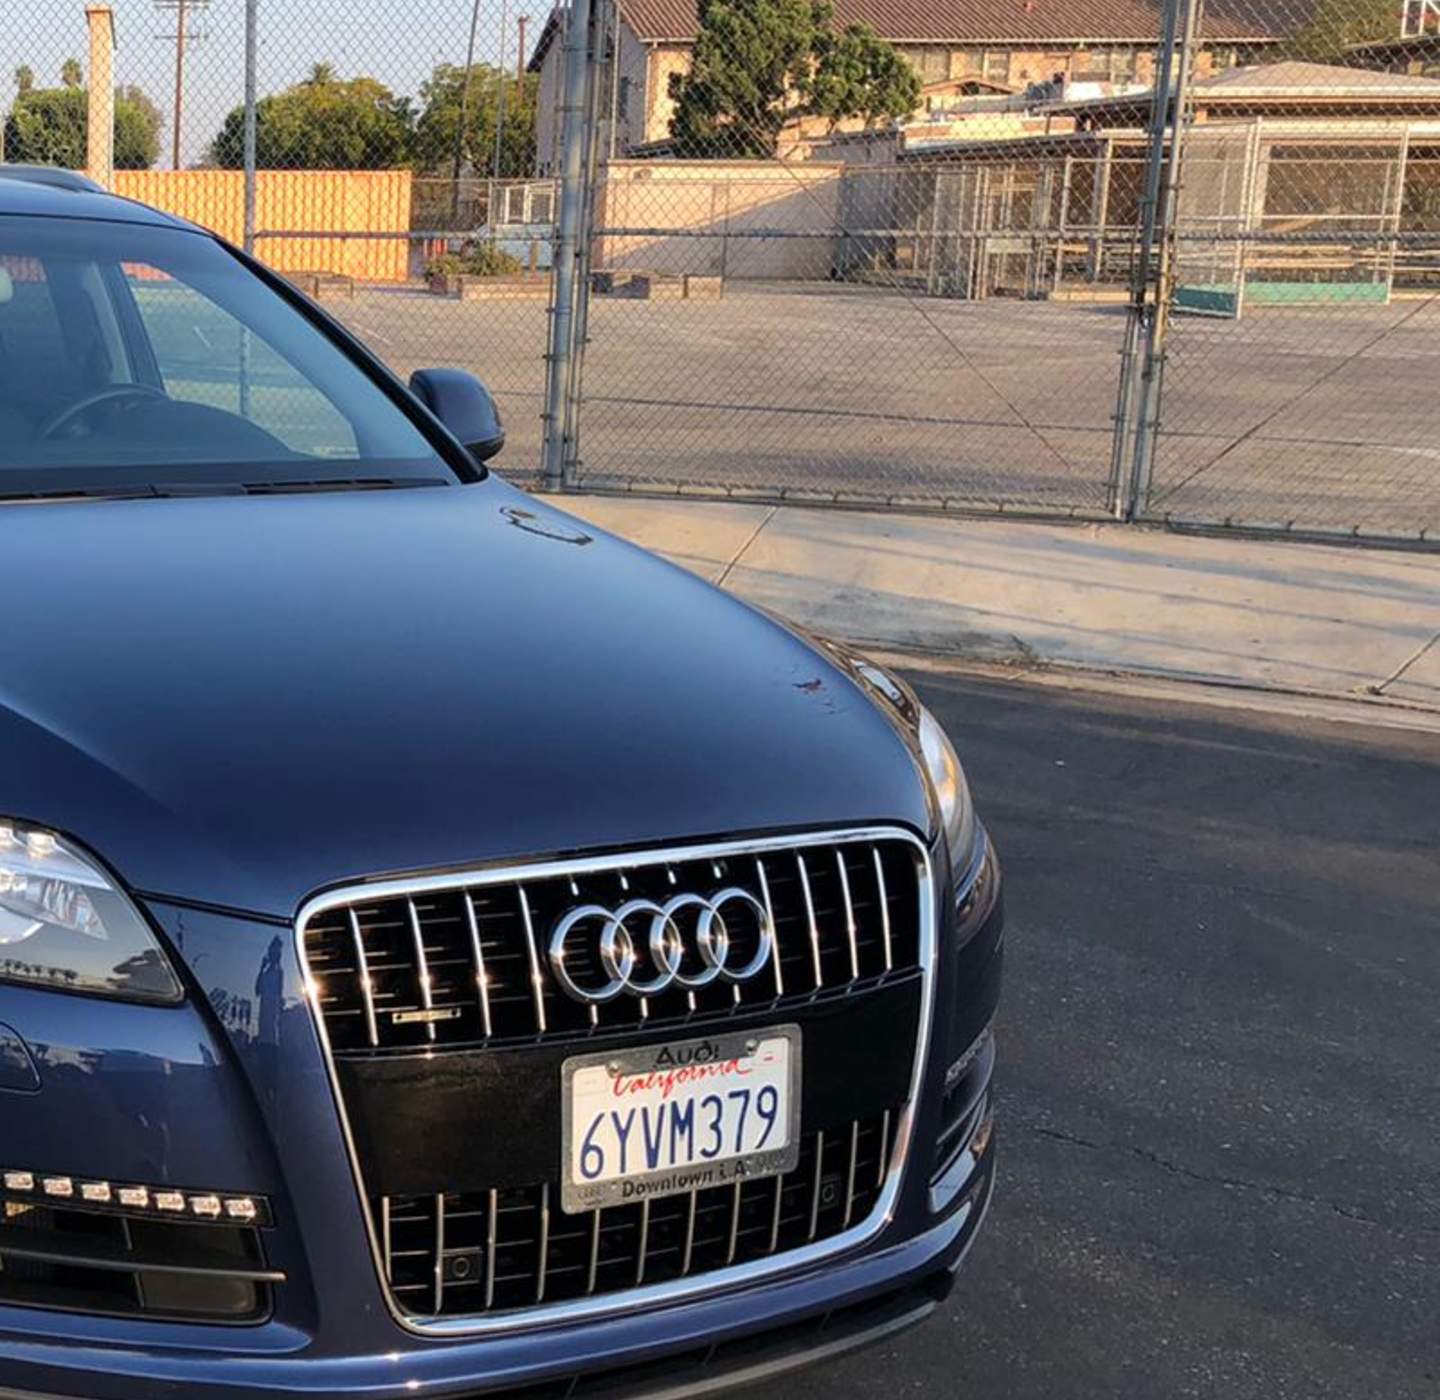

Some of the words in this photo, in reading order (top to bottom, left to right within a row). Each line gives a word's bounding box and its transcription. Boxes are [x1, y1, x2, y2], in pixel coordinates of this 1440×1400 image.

[613, 1058, 752, 1098] California
[580, 1085, 779, 1179] 6YVM379
[622, 1169, 713, 1198] Downtown
